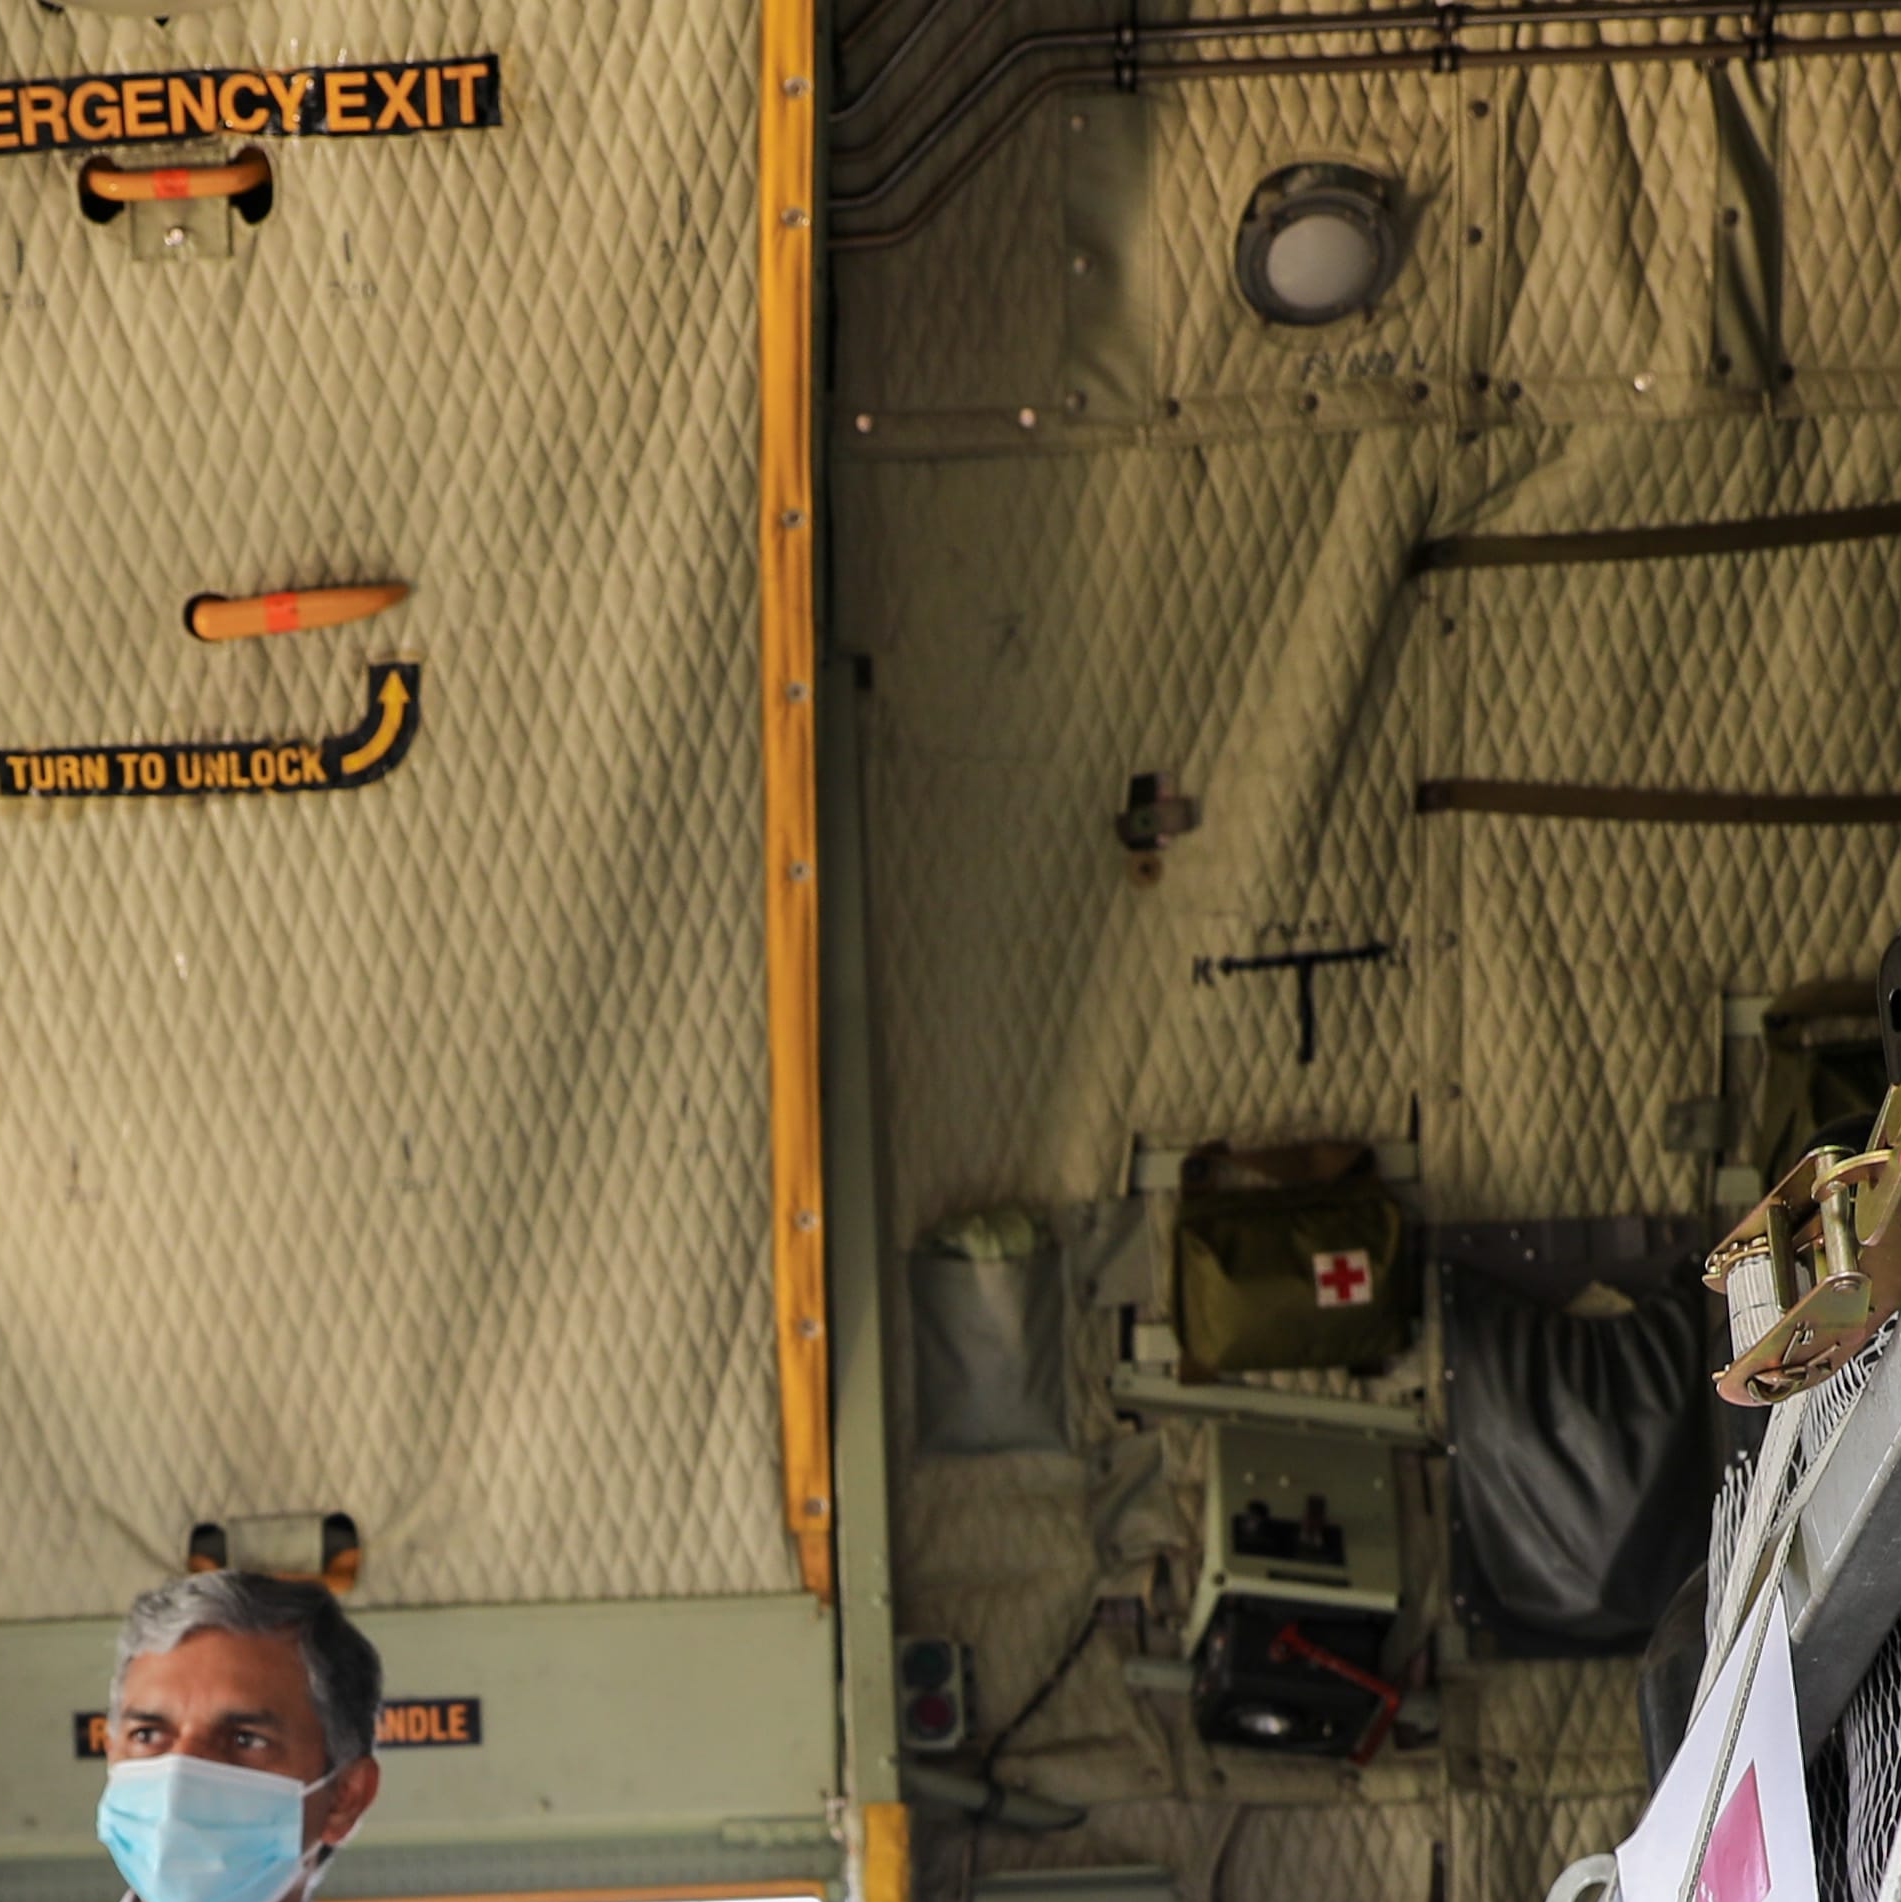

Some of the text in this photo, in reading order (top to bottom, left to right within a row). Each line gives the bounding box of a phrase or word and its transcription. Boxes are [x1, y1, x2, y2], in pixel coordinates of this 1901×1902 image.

[324, 63, 489, 132] EXIT
[6, 744, 327, 791] TURN TO UNLOCK
